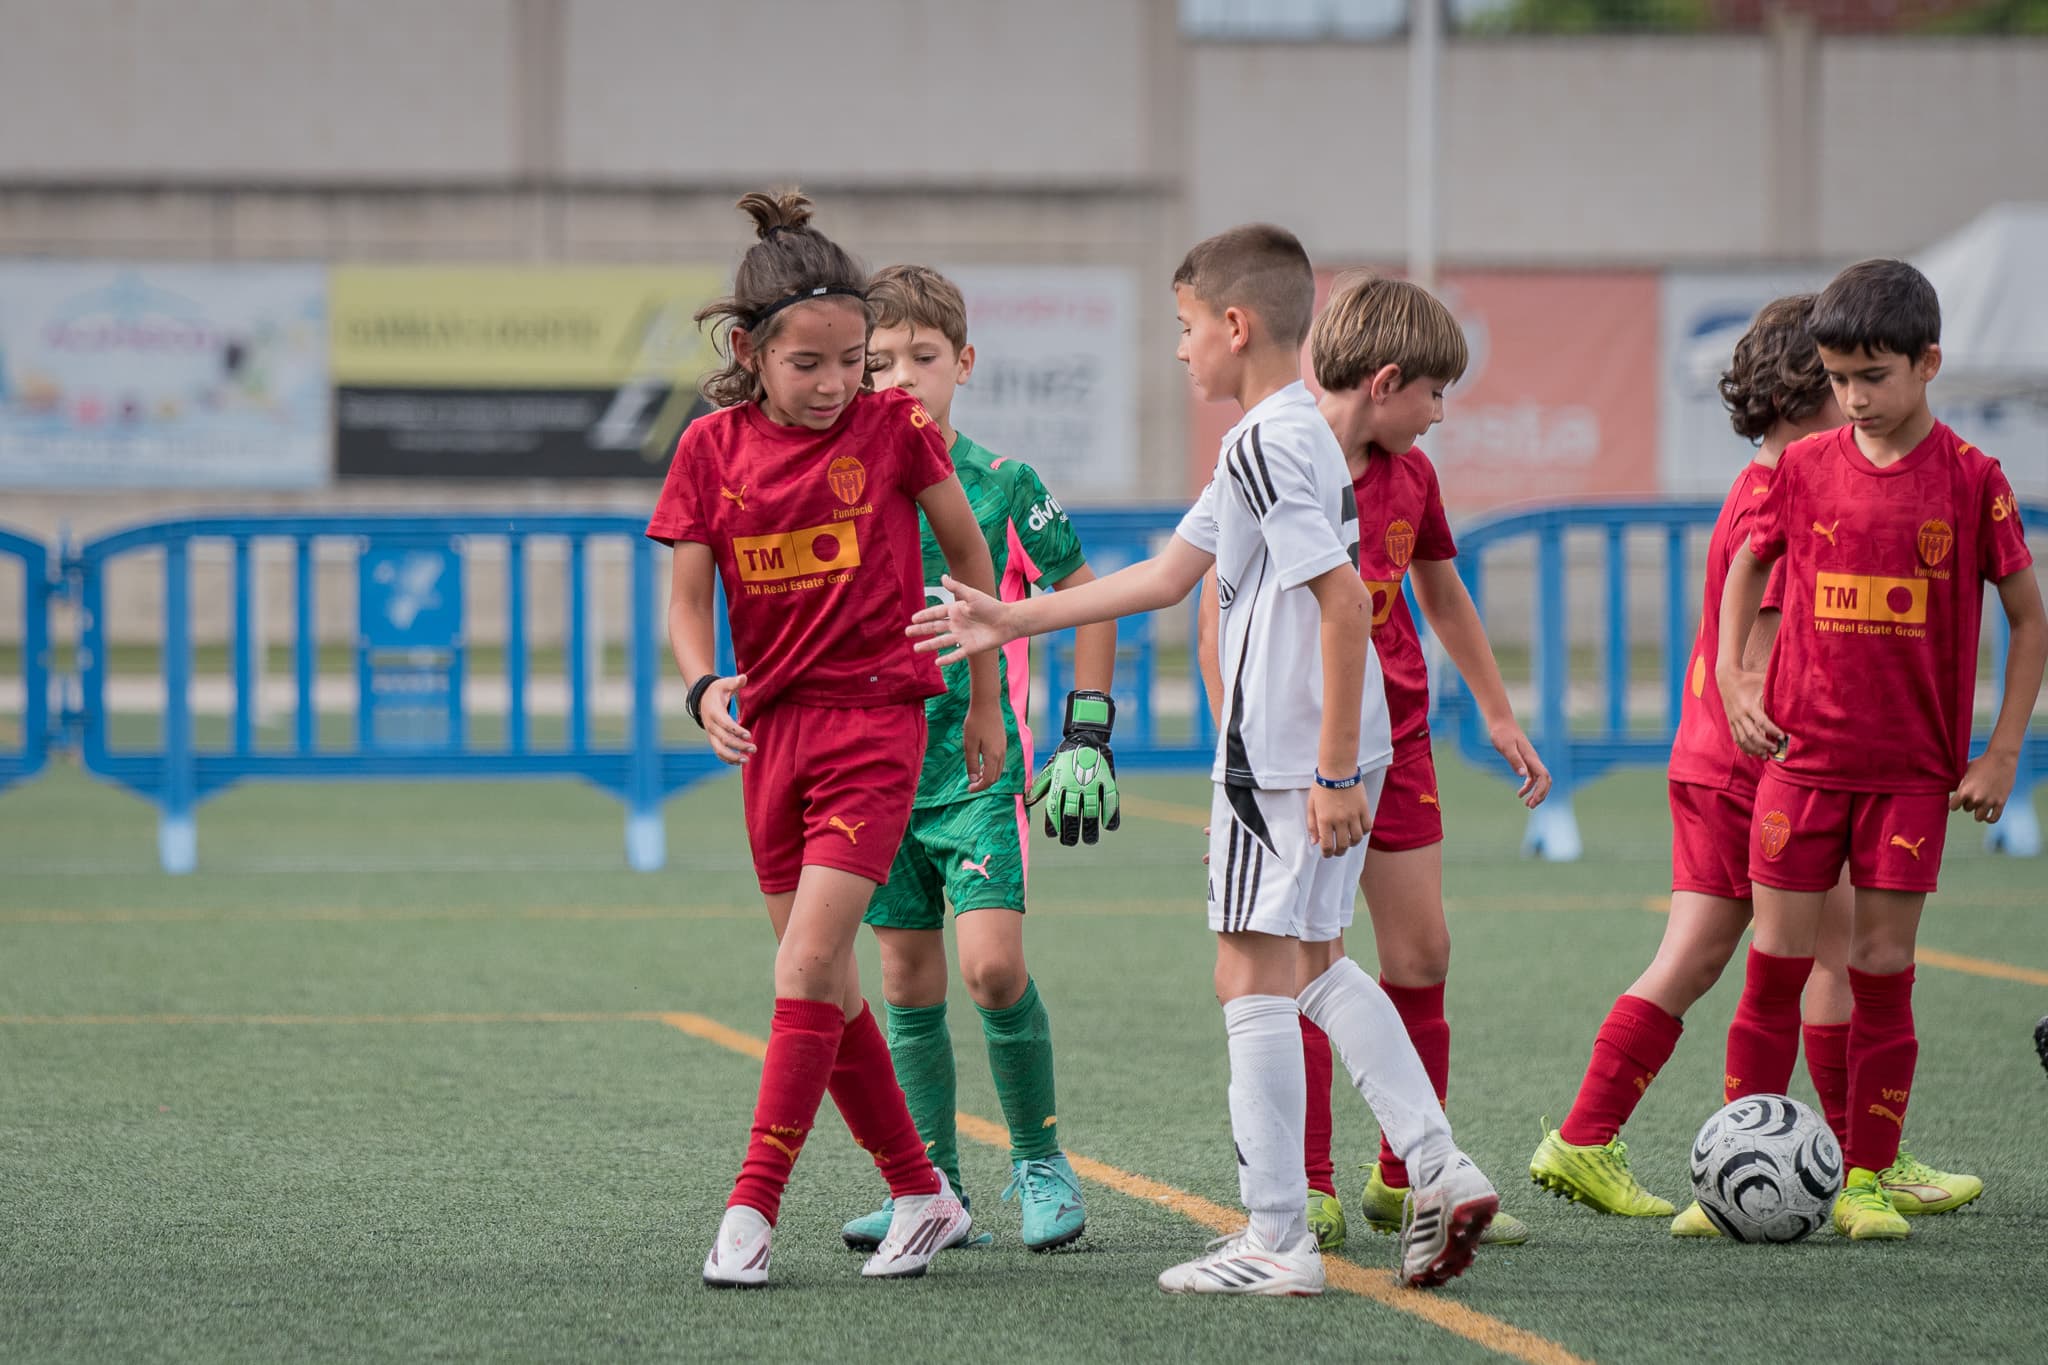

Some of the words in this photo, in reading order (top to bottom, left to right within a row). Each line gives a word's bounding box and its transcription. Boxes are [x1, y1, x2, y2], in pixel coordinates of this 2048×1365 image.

[833, 502, 873, 520] Fundació
[743, 547, 785, 571] TM
[744, 584, 761, 596] TM
[764, 583, 787, 595] Real
[790, 577, 825, 590] Estate
[827, 572, 856, 585] Grou
[1823, 586, 1858, 609] TM
[1814, 620, 1829, 632] TM
[1832, 621, 1855, 633] Real
[1857, 623, 1892, 635] Estate
[1895, 625, 1926, 638] Group
